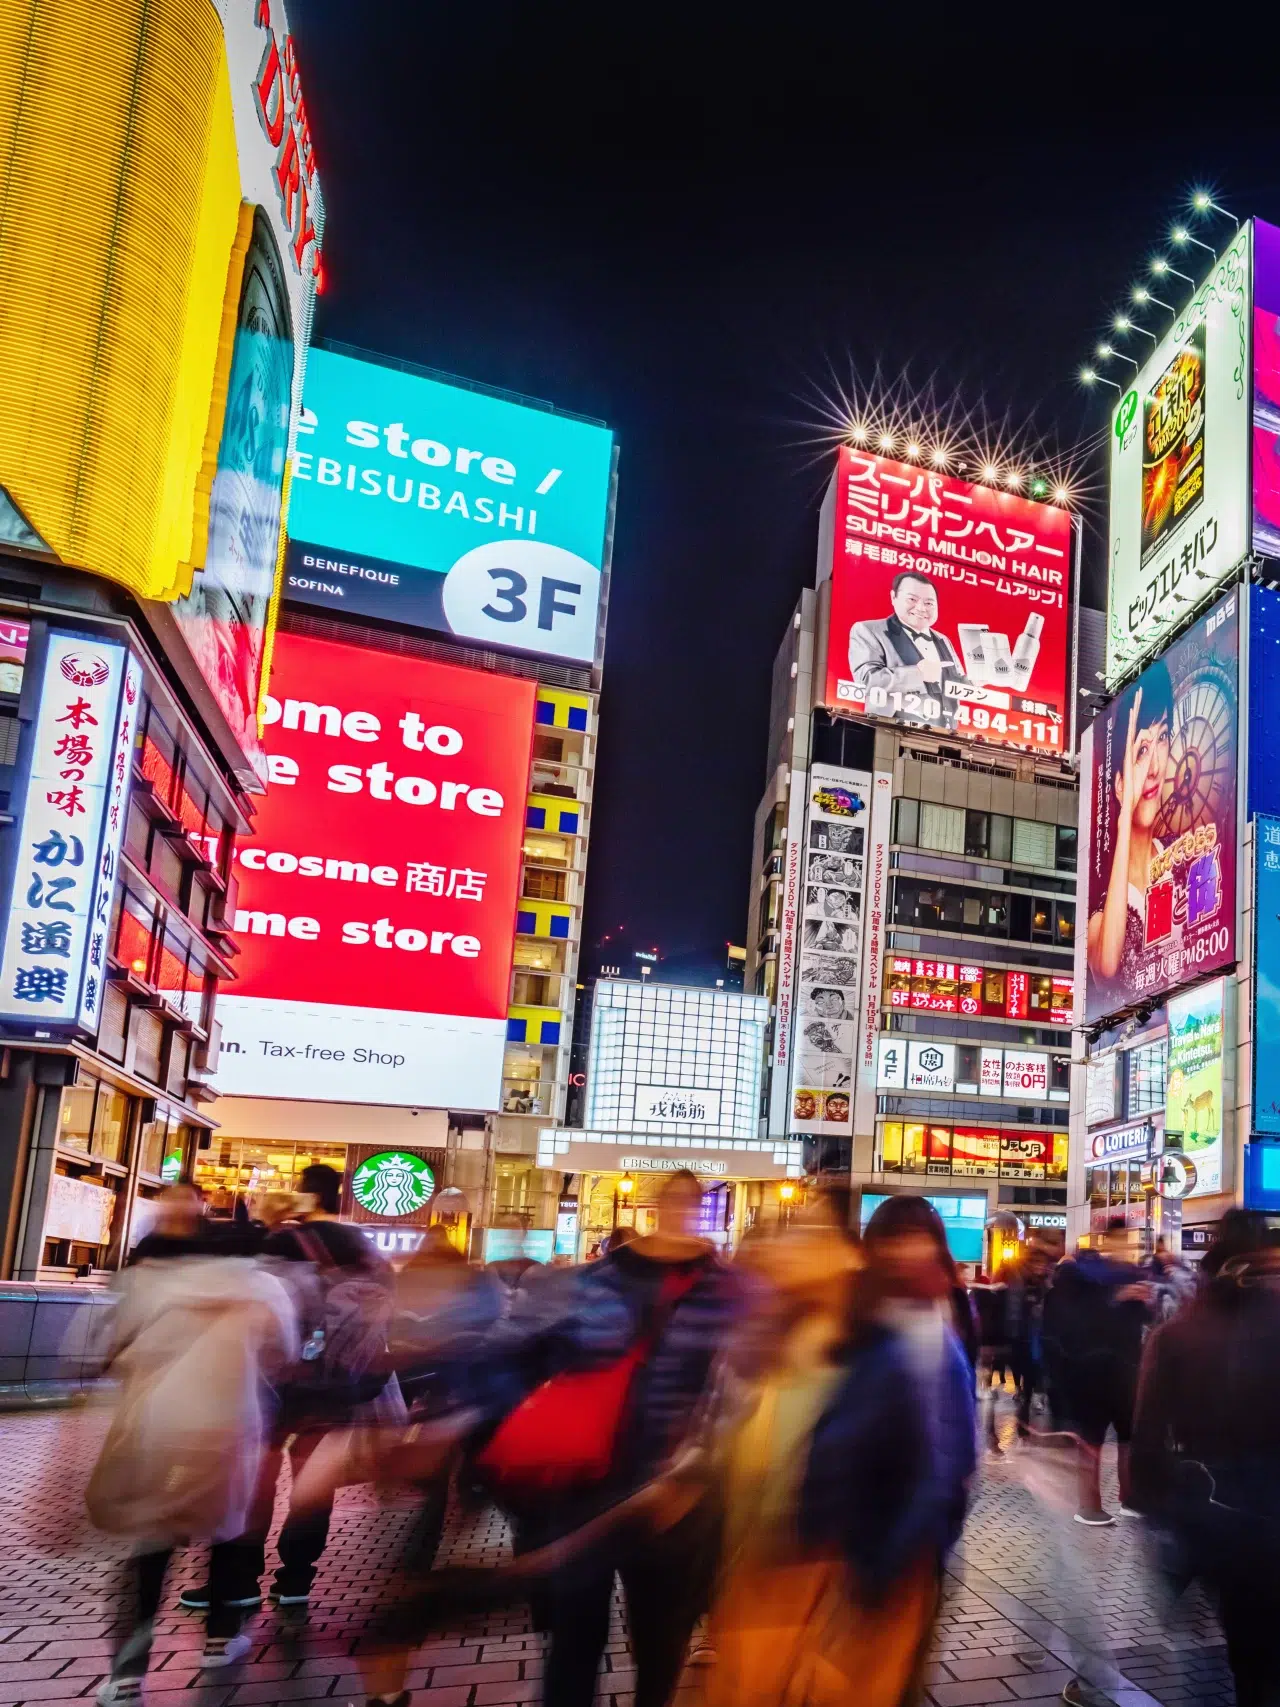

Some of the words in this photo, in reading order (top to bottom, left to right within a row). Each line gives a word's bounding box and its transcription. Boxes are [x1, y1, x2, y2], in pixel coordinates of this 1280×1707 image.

[345, 420, 517, 486] store
[848, 455, 973, 505] スーパー
[847, 484, 1064, 558] ミリオンヘアー
[303, 555, 400, 585] BENEFIQUE
[846, 514, 921, 548] SUPER
[928, 540, 1006, 574] MILLION
[1012, 561, 1063, 587] HAIR
[288, 576, 345, 596] SOFINA
[1127, 515, 1219, 634] ピップエレキバン
[481, 567, 582, 631] 3F
[1205, 599, 1236, 637] MBS
[949, 685, 988, 701] ルアン
[398, 711, 464, 756] to
[869, 686, 1059, 745] 0120-494-111
[46, 696, 99, 818] 本場の味
[327, 761, 505, 817] store
[405, 861, 488, 902] 商店
[342, 917, 481, 958] store
[892, 991, 909, 1005] 5F
[258, 1040, 346, 1062] Tax-free
[353, 1048, 406, 1069] Shop
[1021, 1073, 1046, 1089] 0円
[649, 1100, 705, 1120] 戎橋筋
